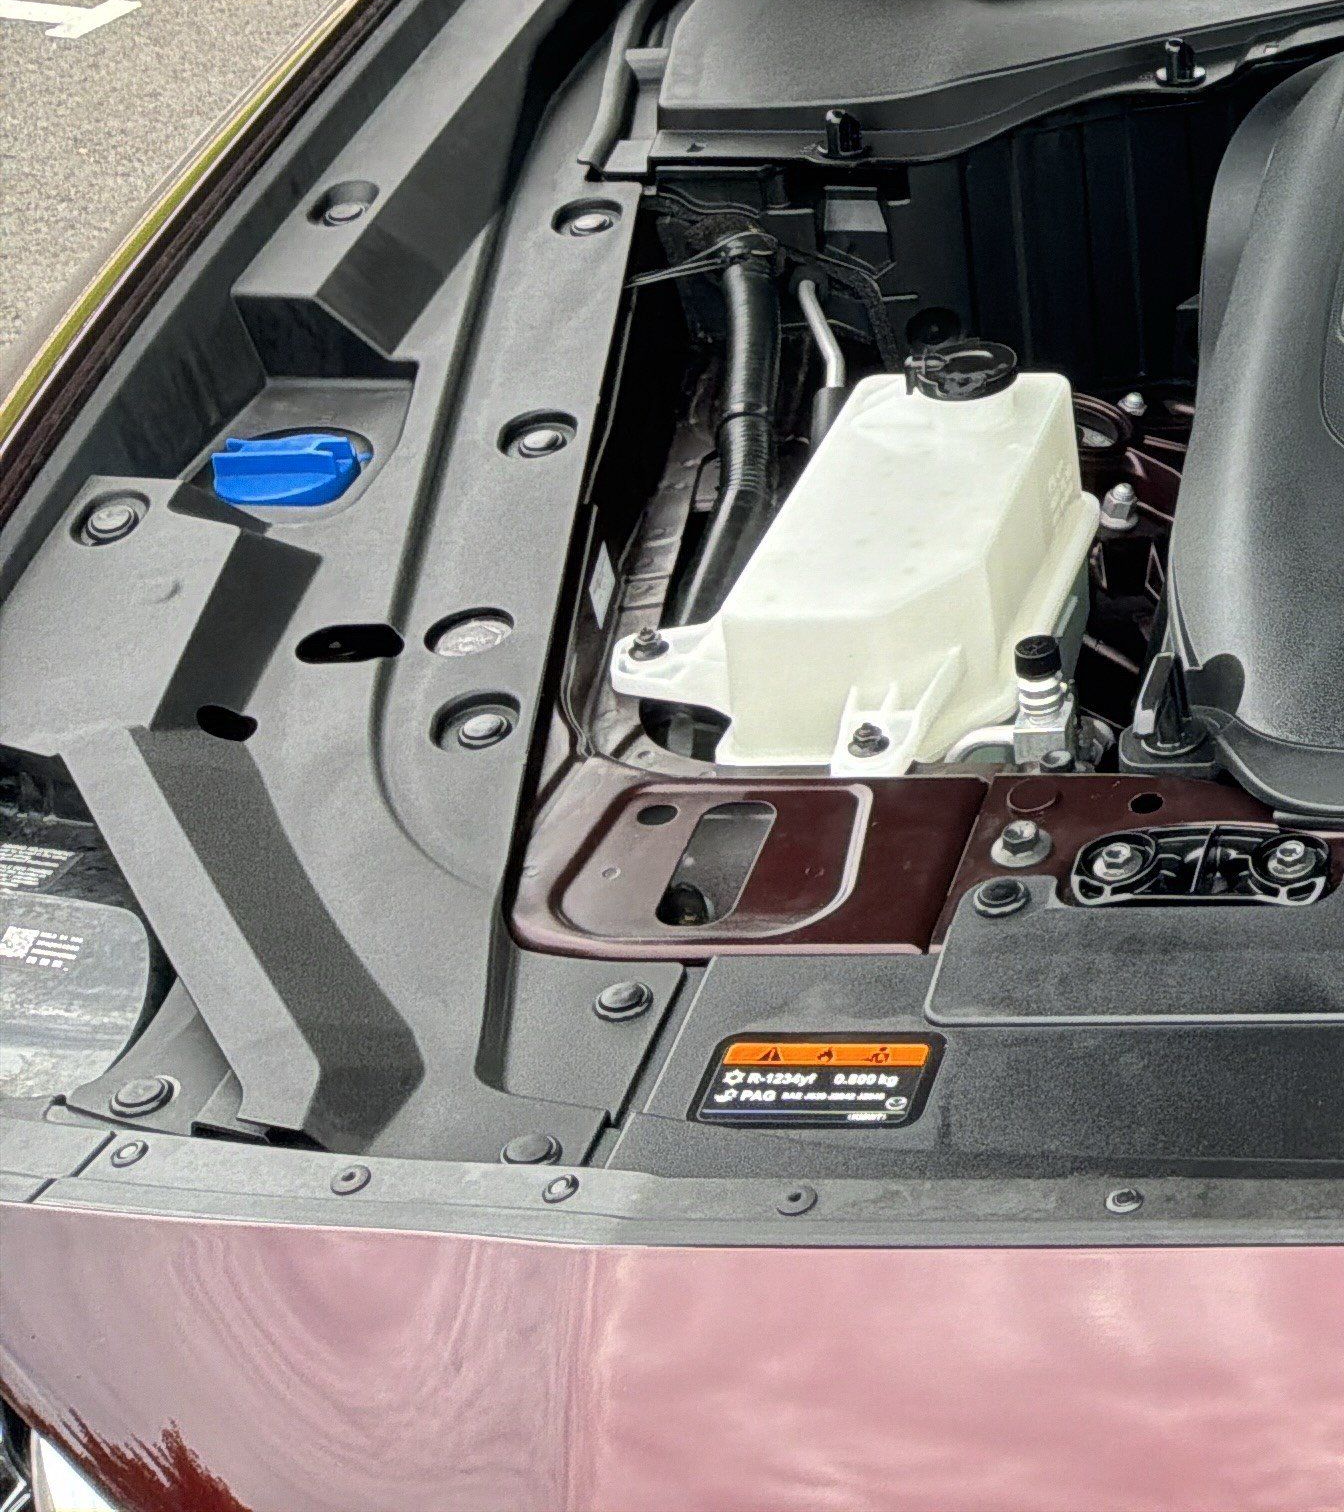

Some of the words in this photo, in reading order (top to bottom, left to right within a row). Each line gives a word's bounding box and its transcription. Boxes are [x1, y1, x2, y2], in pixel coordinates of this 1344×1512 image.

[747, 1073, 817, 1087] R-1234yf
[878, 1073, 899, 1088] kg
[740, 1090, 777, 1102] PAG
